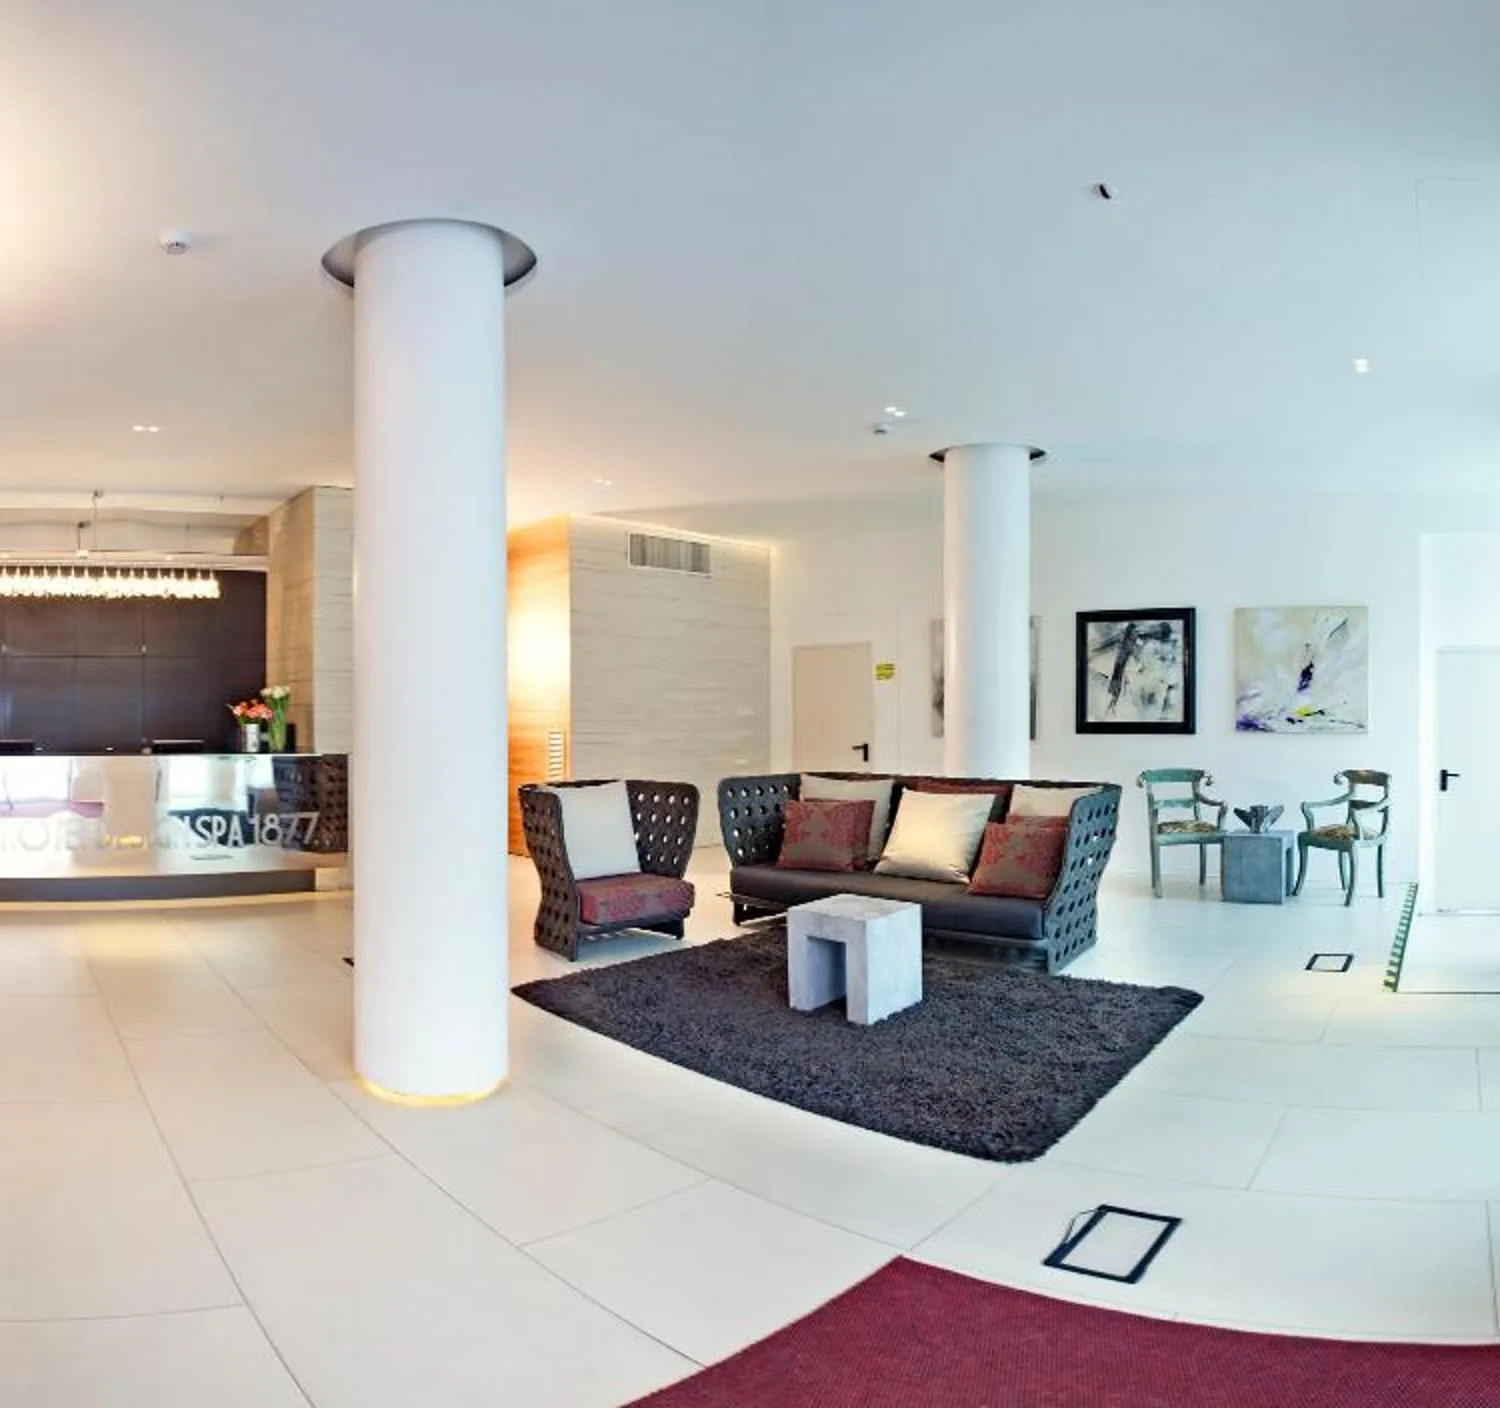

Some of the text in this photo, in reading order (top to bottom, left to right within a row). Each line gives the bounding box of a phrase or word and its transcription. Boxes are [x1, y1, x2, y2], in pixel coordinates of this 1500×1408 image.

[0, 818, 91, 852] OTE
[195, 814, 244, 849] SPA
[248, 811, 320, 846] 1877
